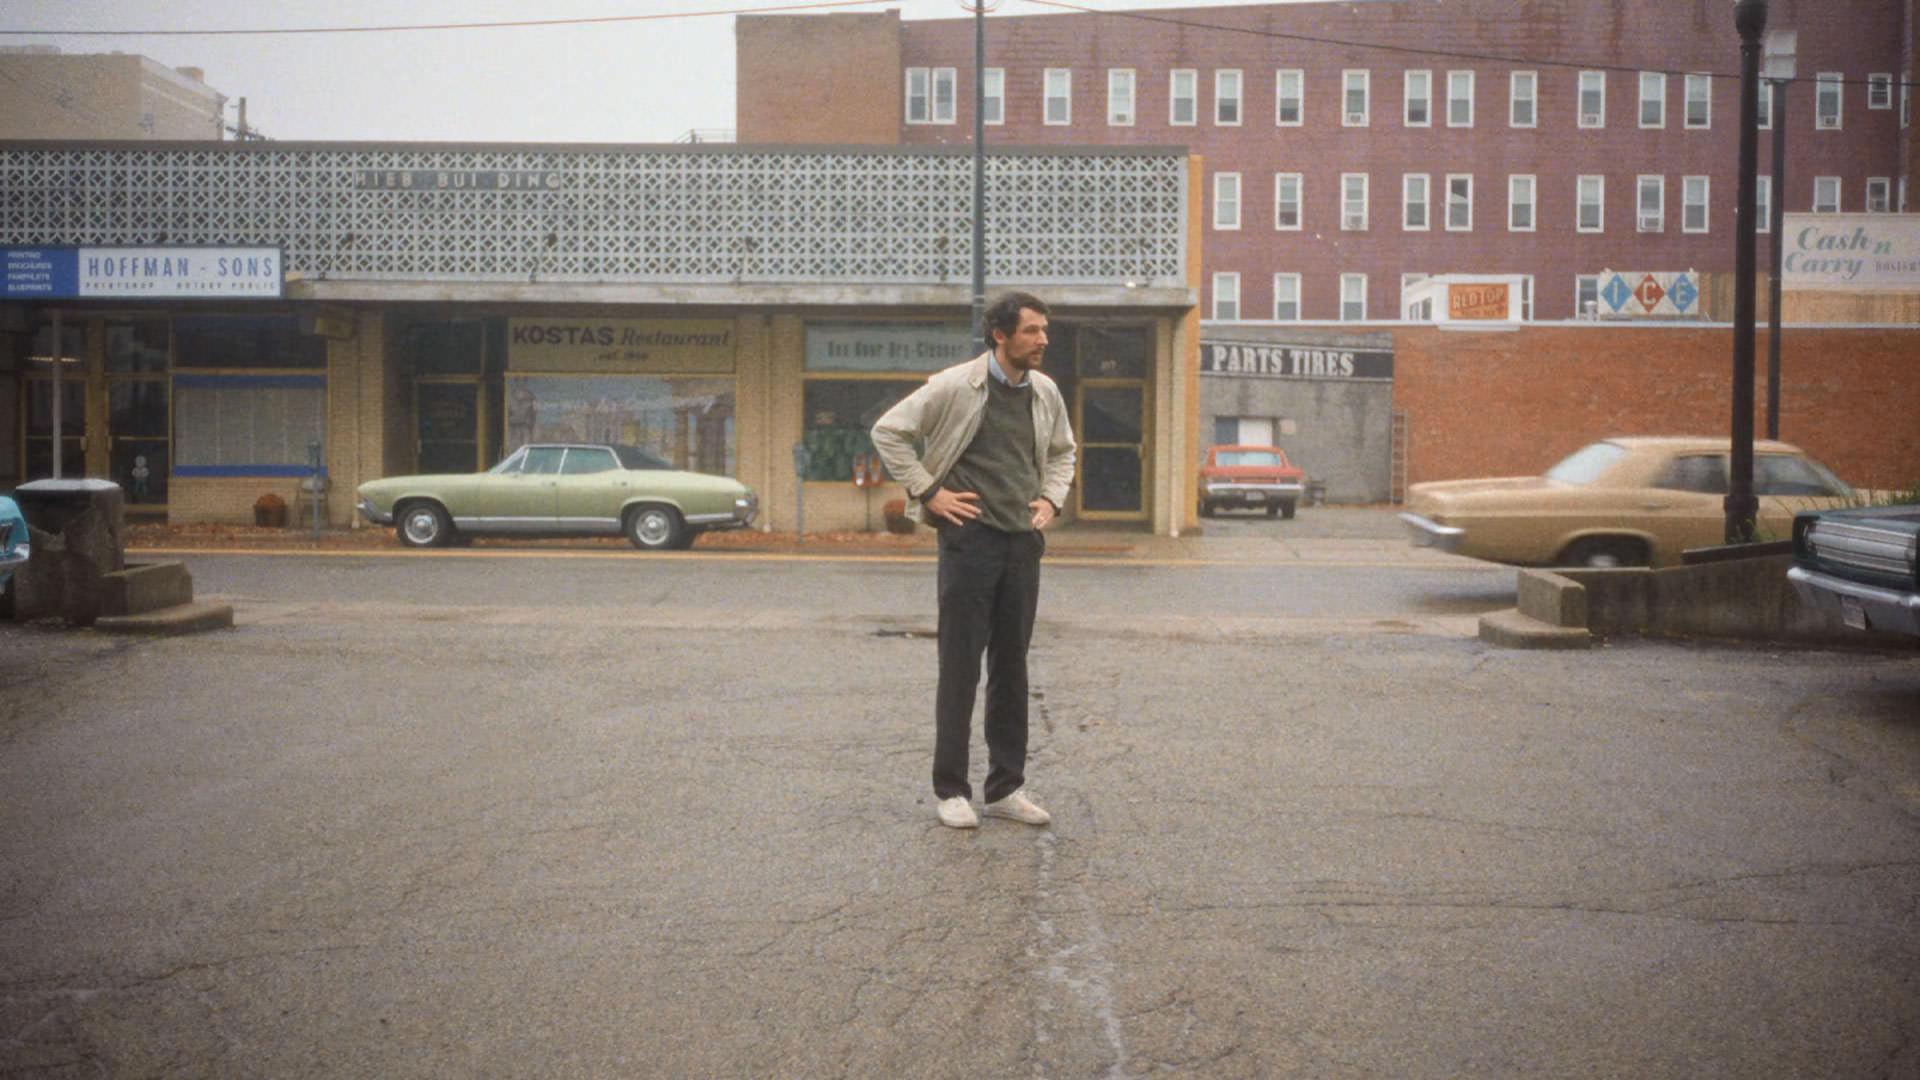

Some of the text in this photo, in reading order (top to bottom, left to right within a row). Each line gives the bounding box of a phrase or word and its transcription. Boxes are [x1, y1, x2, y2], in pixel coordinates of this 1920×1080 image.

[356, 172, 413, 189] HIEB
[1797, 226, 1872, 251] Cash
[88, 256, 190, 278] HOFFMAN
[218, 256, 273, 278] SONS
[1785, 251, 1865, 280] Carry
[513, 326, 730, 347] KOSTAS Restaurant
[1211, 344, 1355, 377] PARTS TIRES
